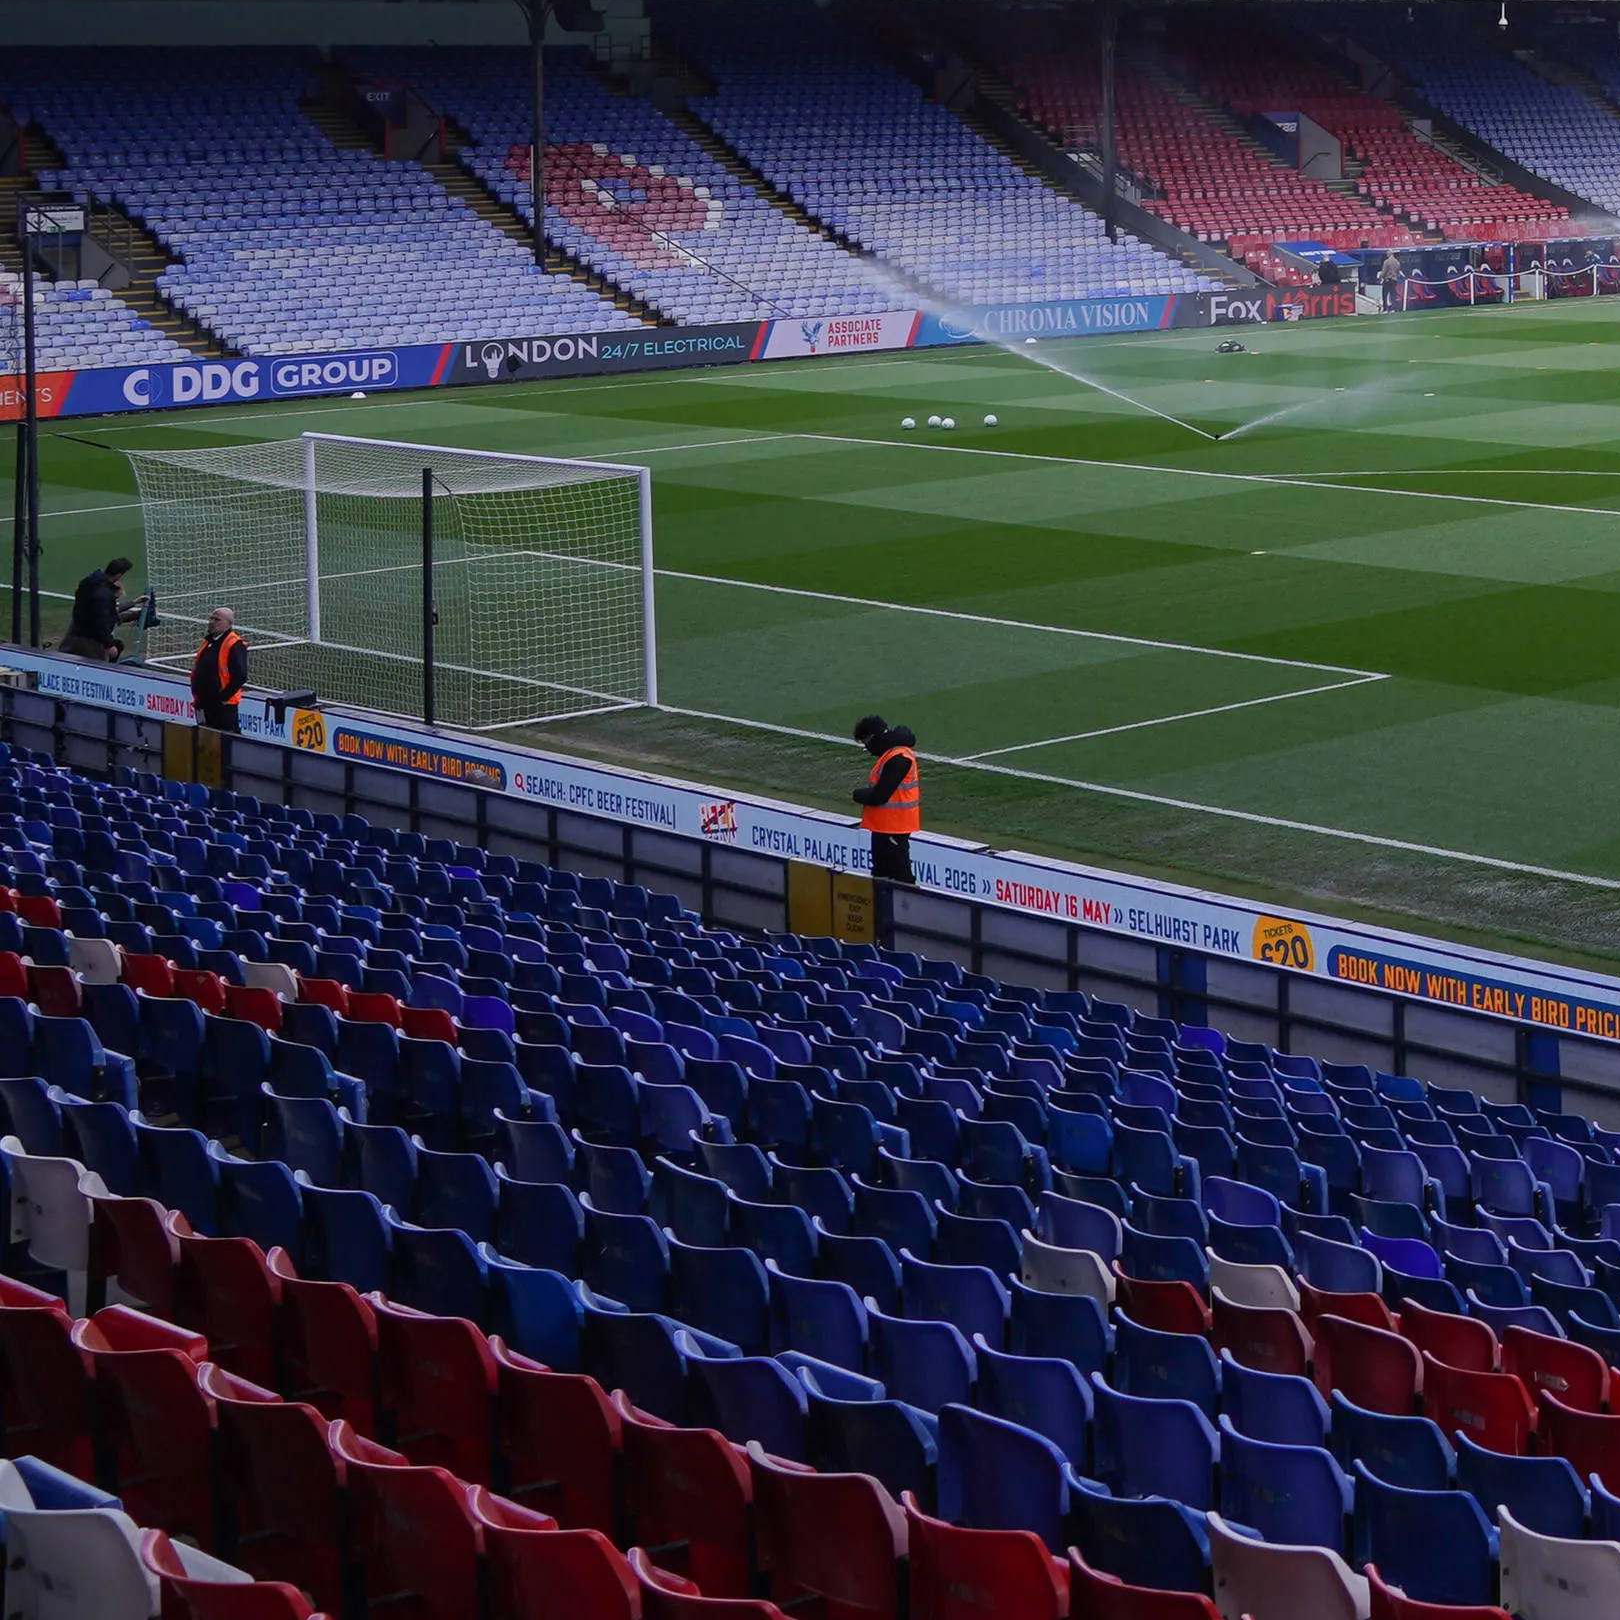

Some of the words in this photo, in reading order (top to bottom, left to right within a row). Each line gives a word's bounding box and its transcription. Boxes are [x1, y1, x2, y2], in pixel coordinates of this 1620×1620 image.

[367, 92, 390, 101] EXIT
[828, 318, 882, 334] ASSOCIATE
[983, 306, 1079, 337] CHROMA
[1081, 300, 1149, 330] VISION
[1211, 296, 1261, 323] Fox
[602, 345, 639, 360] 24/7
[644, 336, 745, 356] ELECTRICAL
[828, 330, 879, 347] PARTNERS
[172, 361, 260, 402] DDG
[276, 358, 393, 388] GROUP
[39, 672, 60, 692] ALACE
[61, 676, 80, 695] BEER
[81, 681, 115, 703] FESTIVAL
[117, 687, 136, 707] 2026
[146, 694, 184, 717] SATURDAY
[186, 702, 194, 719] 16
[338, 733, 360, 754] BOOK
[363, 737, 383, 759] NOW
[386, 741, 408, 765] WITH
[411, 749, 439, 773] EARLY
[442, 756, 462, 779] BIRD
[526, 776, 566, 801] SEARCH:
[569, 785, 593, 809] CPFC
[597, 790, 622, 815] BEER
[752, 825, 800, 856] CRYSTAL
[804, 837, 847, 866] PALACE
[945, 867, 976, 894] 2026
[995, 879, 1060, 914] SATURDAY
[1065, 894, 1078, 917] 16
[1082, 899, 1111, 925] MAY
[1129, 908, 1198, 944] SELHURST
[1203, 927, 1240, 954] PARK
[1263, 924, 1294, 939] TICKETS
[1338, 953, 1377, 985] BOOK
[1384, 965, 1421, 995] NOW
[1426, 974, 1466, 1005] WITH
[1473, 984, 1525, 1018] EARLY
[1532, 997, 1569, 1028] BIRD
